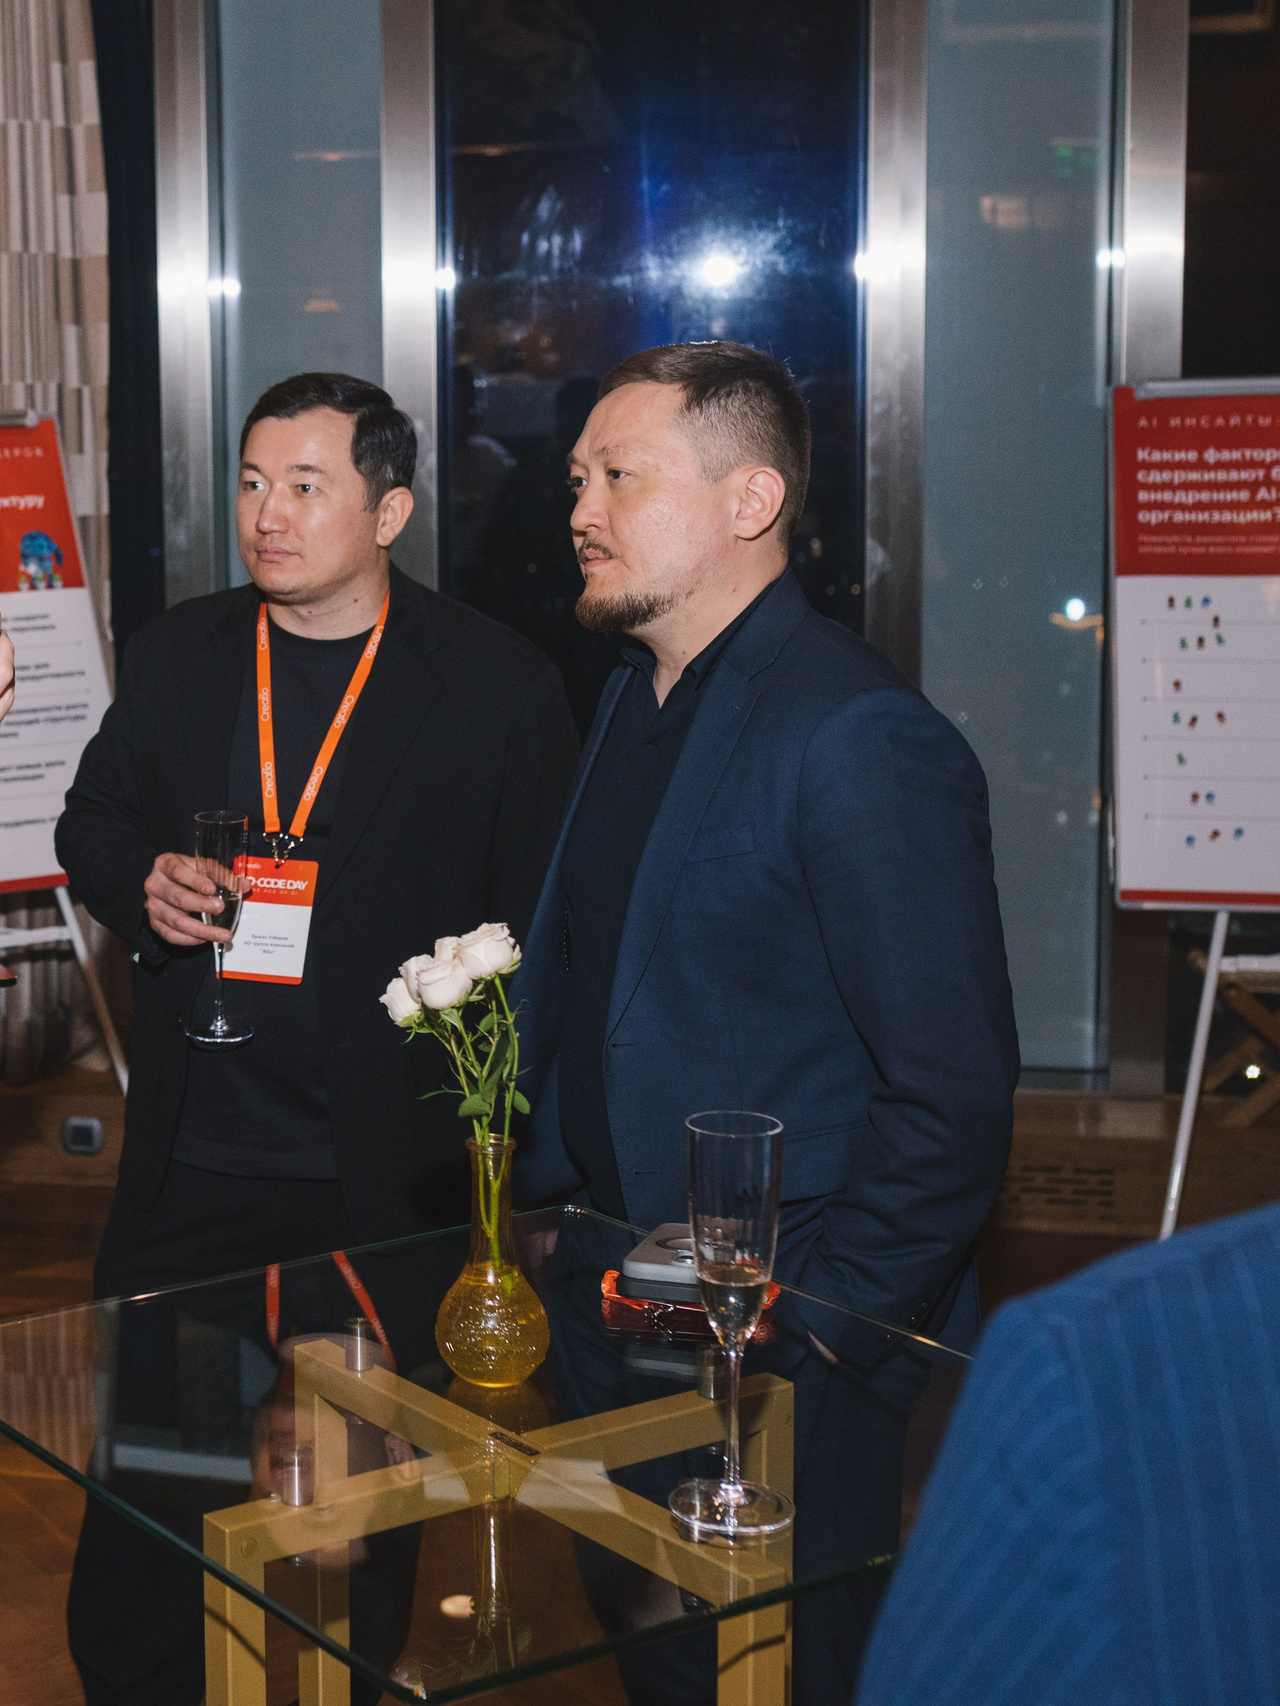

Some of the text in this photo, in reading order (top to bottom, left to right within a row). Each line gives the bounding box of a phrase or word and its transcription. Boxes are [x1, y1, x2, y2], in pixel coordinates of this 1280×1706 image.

[1137, 415, 1158, 428] AI
[1136, 445, 1280, 465] Какие фактор
[1136, 468, 1266, 486] сдерживают
[1137, 488, 1251, 506] внедрение
[258, 616, 266, 651] Creatio
[365, 624, 385, 659] Creatio
[259, 687, 269, 722] Creatio
[333, 694, 355, 729] Creatio
[263, 761, 274, 798] Creatio
[303, 765, 324, 801] Creatio
[247, 876, 309, 891] O-CODE DAY
